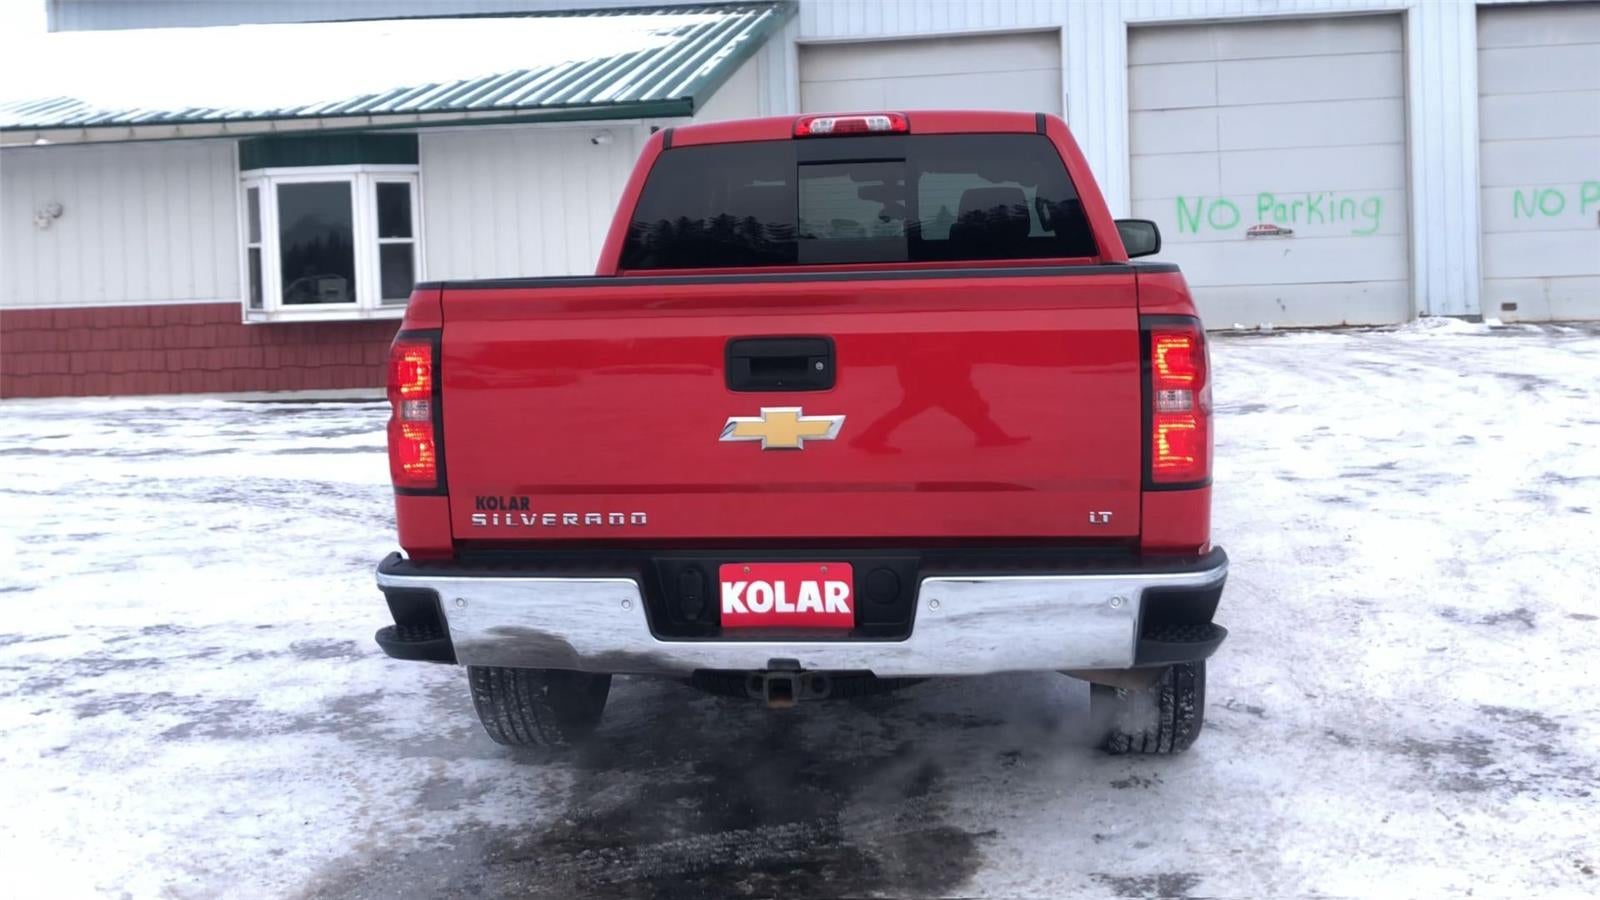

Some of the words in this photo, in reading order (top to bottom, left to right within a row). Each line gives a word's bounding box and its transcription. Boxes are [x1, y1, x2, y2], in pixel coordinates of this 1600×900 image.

[1176, 196, 1240, 234] NO
[1513, 188, 1566, 218] NO
[475, 496, 530, 511] KOLAR
[1089, 511, 1112, 523] LT
[721, 580, 851, 613] KOLAR
